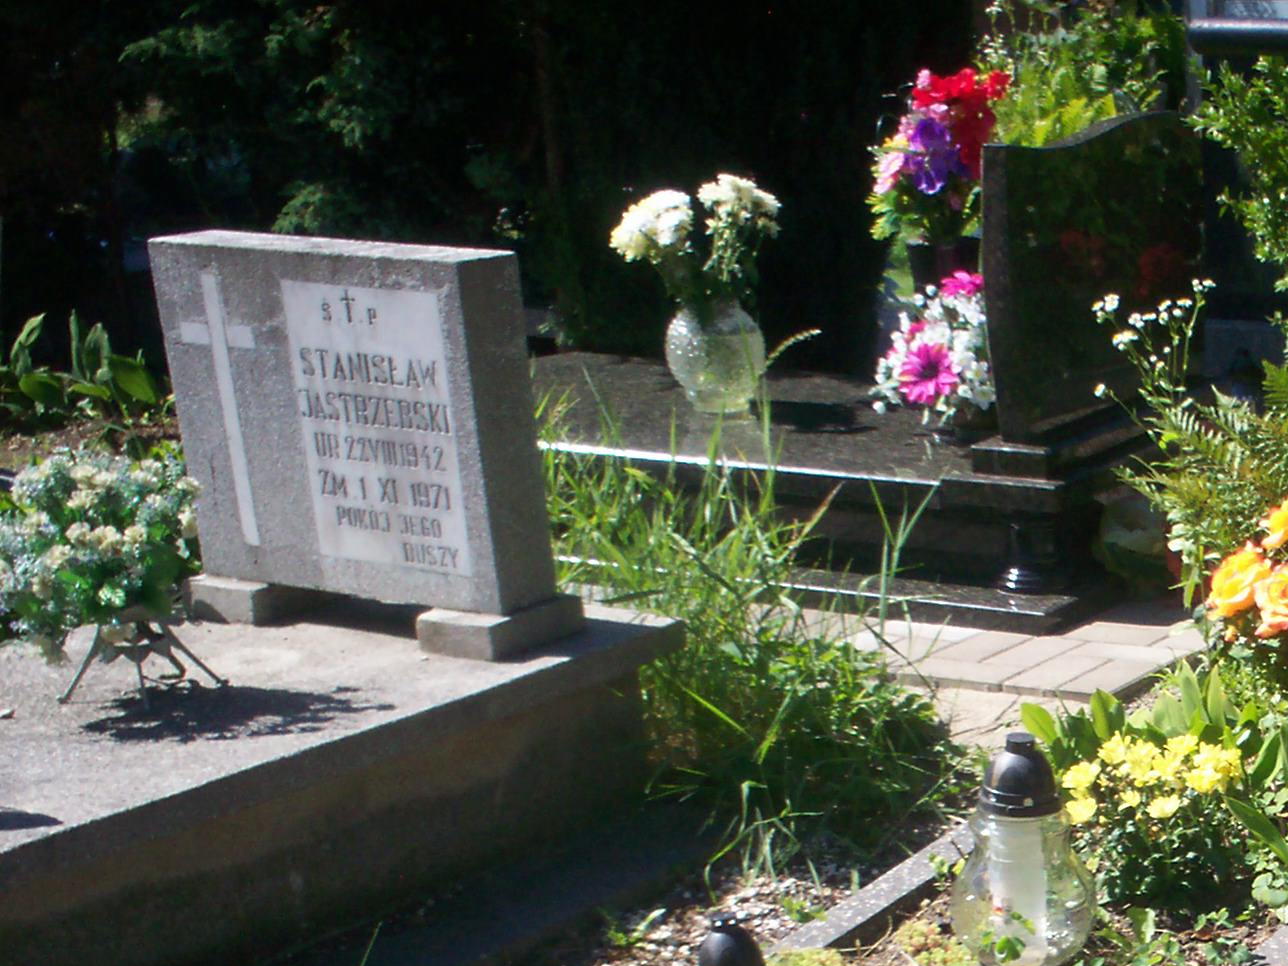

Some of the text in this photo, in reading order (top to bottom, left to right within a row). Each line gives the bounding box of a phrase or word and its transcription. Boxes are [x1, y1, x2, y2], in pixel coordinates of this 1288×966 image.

[299, 347, 437, 388] STANISŁAW
[318, 468, 348, 498] ZM
[399, 513, 442, 538] JEGO
[402, 542, 459, 568] DUSZY
